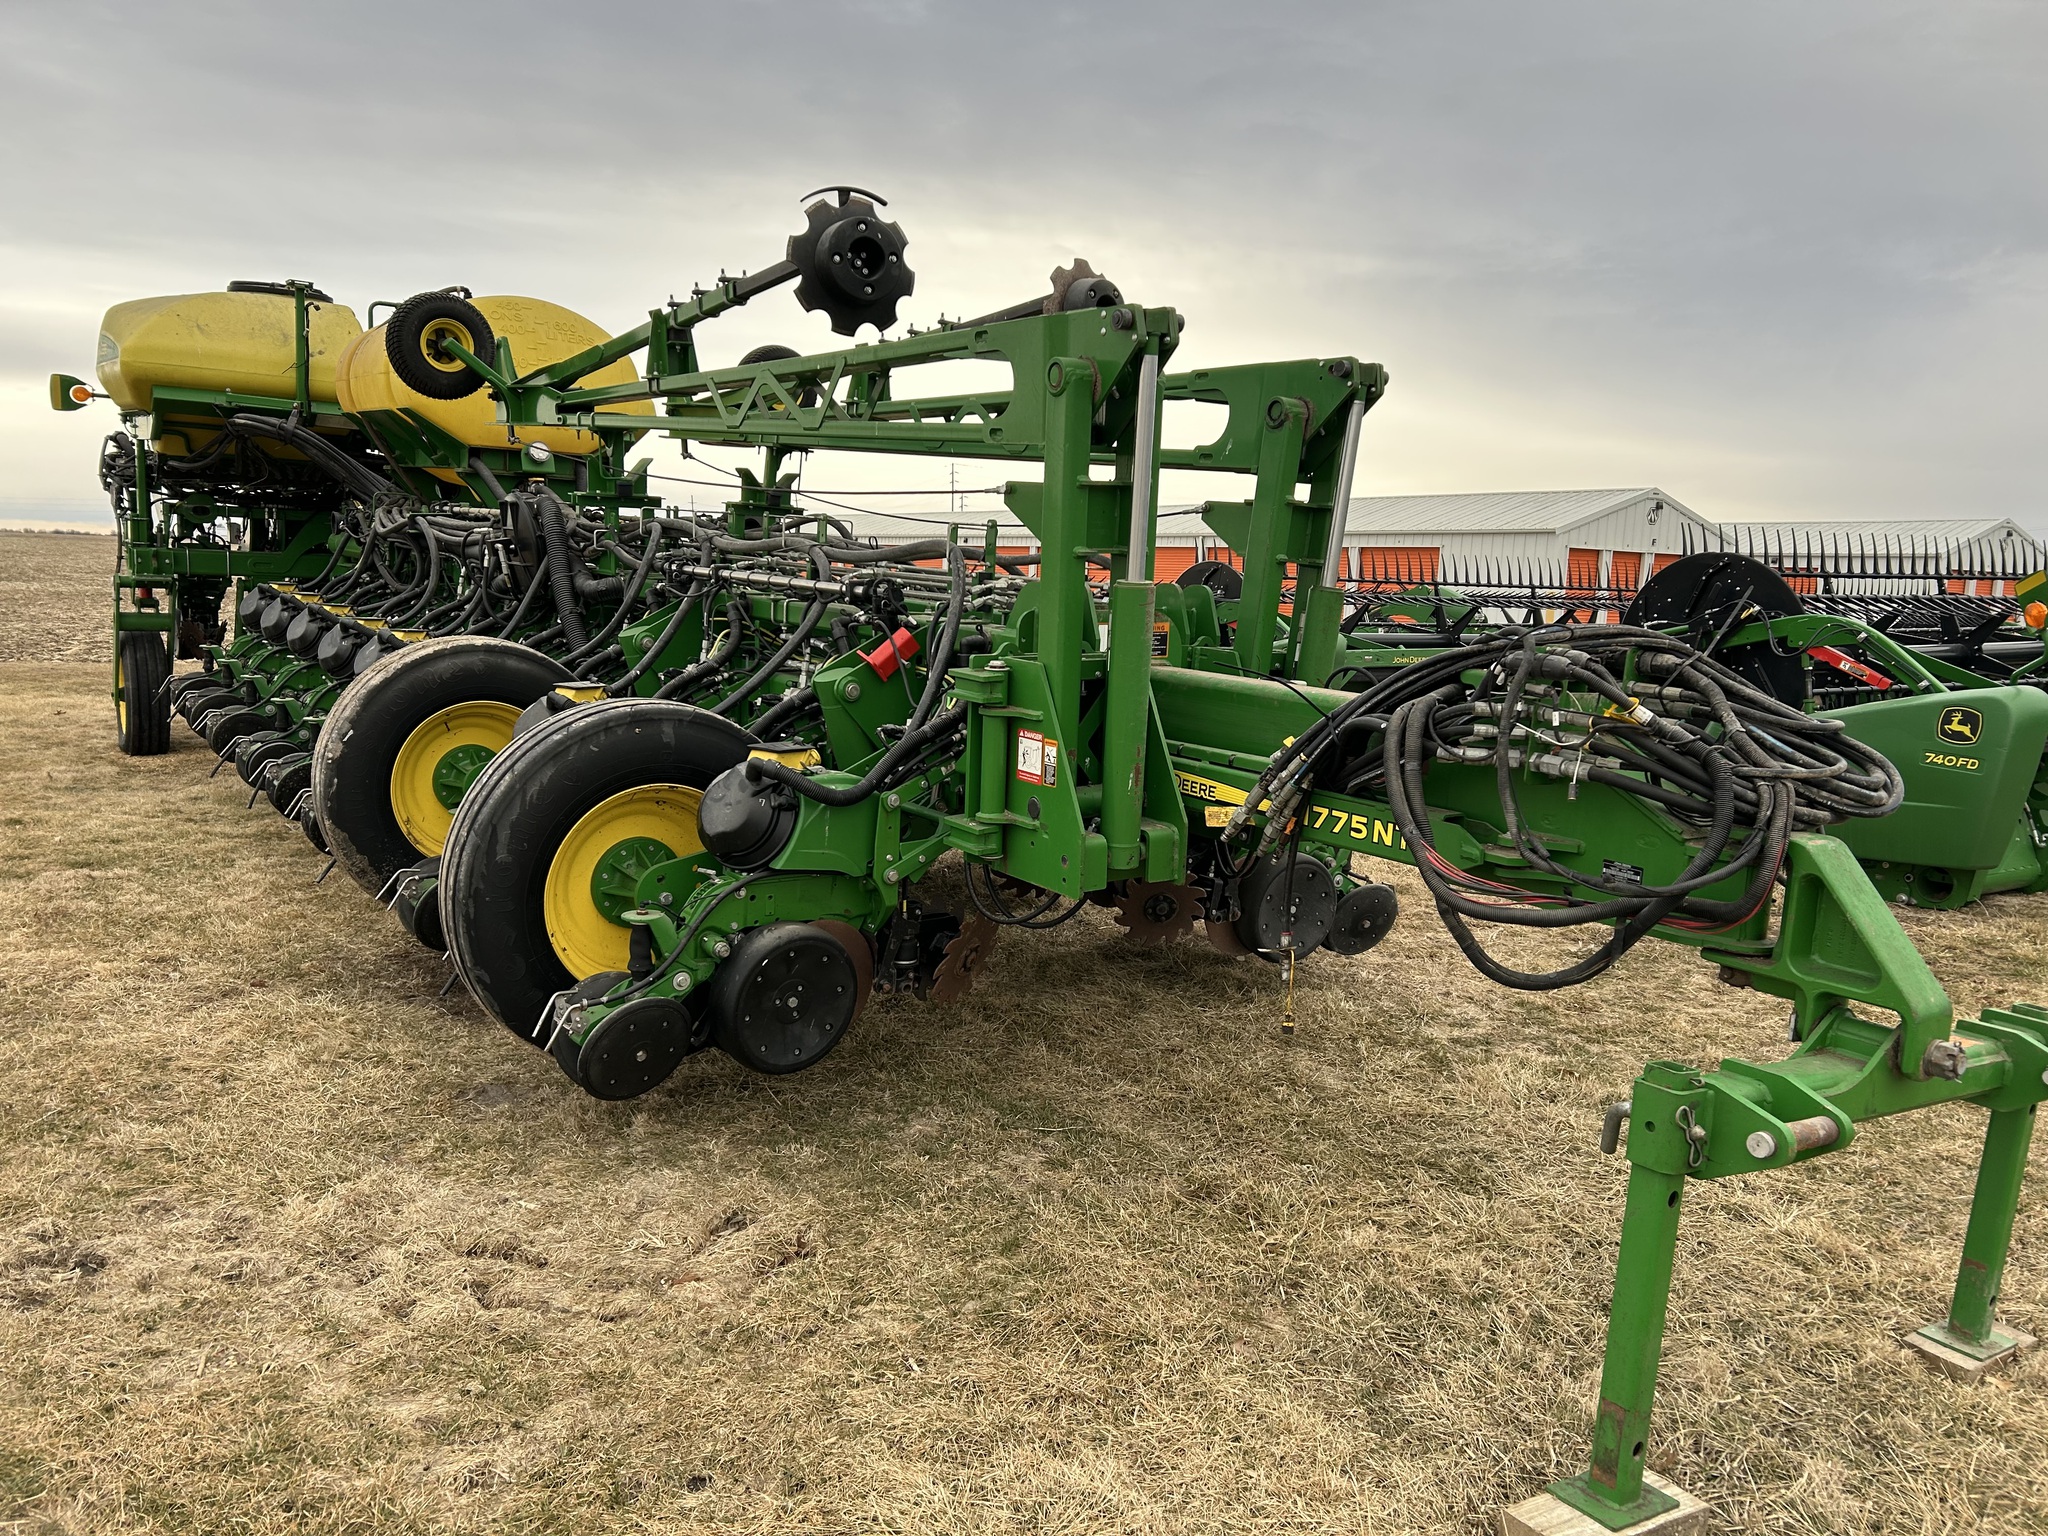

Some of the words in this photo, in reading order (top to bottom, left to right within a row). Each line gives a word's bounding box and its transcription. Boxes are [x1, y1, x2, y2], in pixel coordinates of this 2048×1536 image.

[500, 324, 526, 335] 400
[545, 330, 595, 346] LITERS
[1651, 538, 1657, 546] F
[1924, 752, 1980, 770] 740FD
[758, 798, 766, 807] 7
